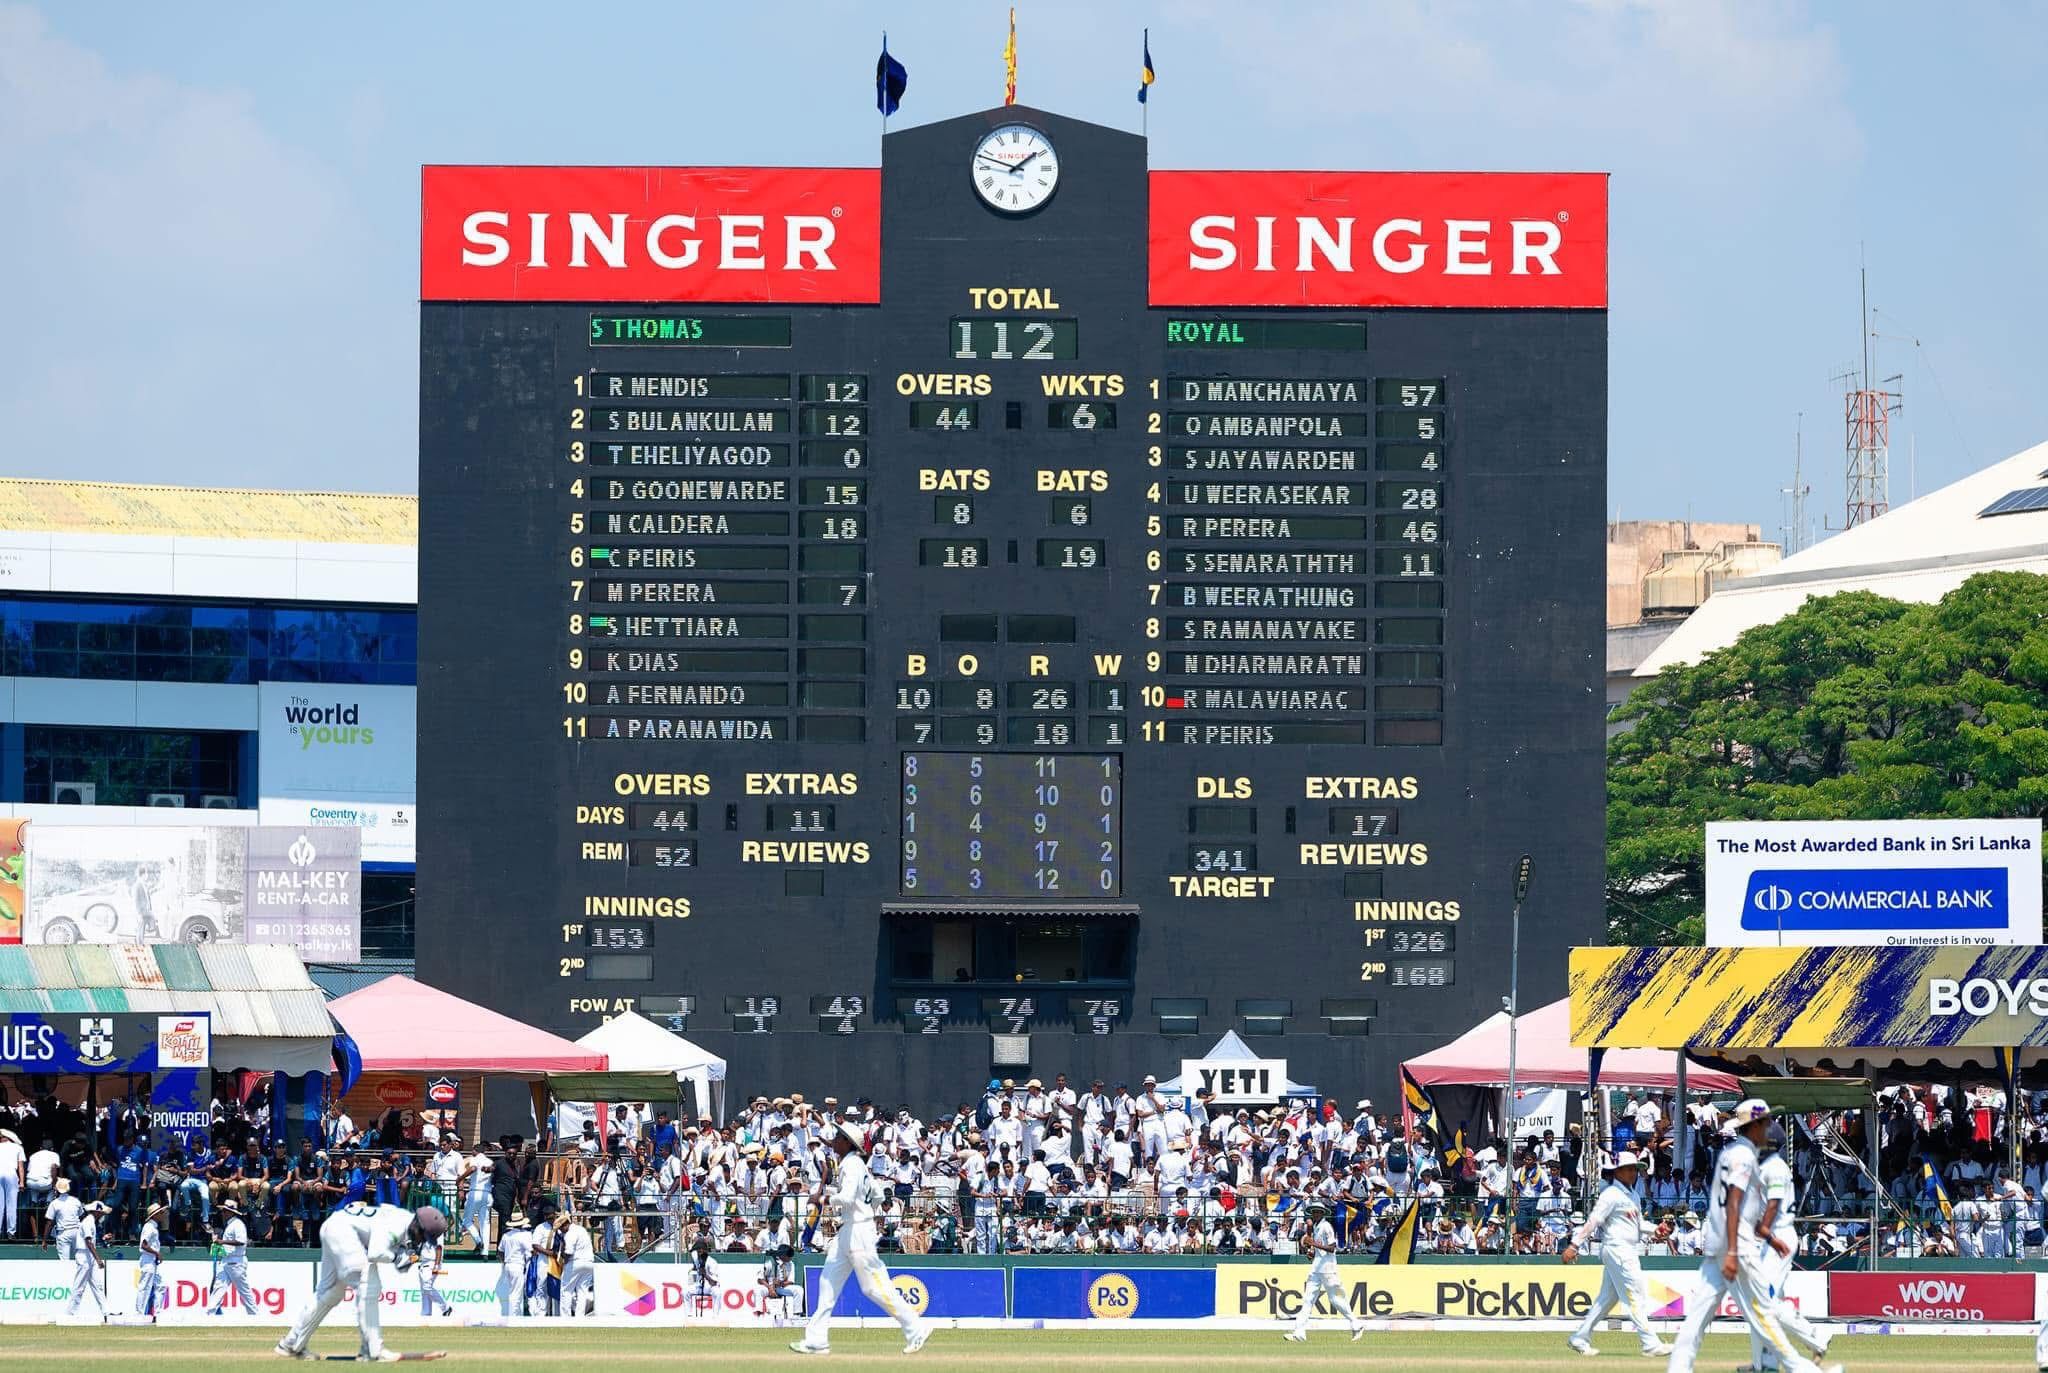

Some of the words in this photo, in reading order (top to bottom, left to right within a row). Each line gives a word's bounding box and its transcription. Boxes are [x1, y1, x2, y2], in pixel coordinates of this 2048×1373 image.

[969, 288, 1059, 309] TOTAL
[592, 320, 602, 338] S
[614, 320, 703, 338] THOMAS
[1168, 322, 1244, 342] ROYAL
[955, 322, 1054, 359] 112
[609, 378, 623, 396] R
[632, 378, 708, 396] MENDIS
[825, 383, 859, 402] 12
[897, 374, 992, 395] OVERS
[1041, 375, 1124, 396] WKTS
[1186, 383, 1199, 401] D
[1208, 383, 1357, 401] MANCHANAYA
[1401, 386, 1437, 407] 57
[609, 412, 620, 431] S
[628, 412, 773, 431] BULANKULAM
[825, 415, 860, 436] 12
[936, 408, 970, 430] 44
[1072, 404, 1096, 429] 6
[1186, 418, 1200, 436] O
[1208, 418, 1342, 436] AMBANPOLA
[1418, 418, 1435, 439] 5
[609, 446, 623, 465] T
[631, 446, 771, 465] EHELIYAGOD
[844, 449, 861, 468] 0
[1186, 451, 1197, 470] S
[1205, 451, 1354, 470] JAYAWARDEN
[1420, 452, 1437, 471] 4
[920, 469, 990, 490] BATS
[1038, 470, 1108, 491] BATS
[609, 481, 624, 500] D
[633, 481, 785, 500] GOONEWARDE
[824, 486, 858, 505] 15
[1185, 486, 1198, 504] U
[1207, 486, 1349, 504] WEERASEKAR
[1402, 489, 1437, 510] 28
[609, 515, 621, 533] N
[629, 515, 728, 533] CALDERA
[953, 504, 970, 524] 8
[1071, 505, 1087, 525] 6
[823, 519, 857, 539] 18
[1184, 518, 1196, 537] R
[1206, 518, 1291, 537] PERERA
[1402, 521, 1437, 542] 46
[609, 550, 620, 567] C
[628, 550, 696, 567] PEIRIS
[943, 547, 977, 567] 18
[1062, 547, 1096, 567] 19
[1185, 554, 1196, 572] S
[1205, 554, 1353, 572] SENARATHTH
[1400, 554, 1435, 576] 11
[608, 583, 622, 601] M
[631, 583, 716, 601] PERERA
[840, 586, 857, 606] 7
[1184, 587, 1196, 606] B
[1205, 587, 1354, 606] WEERATHUNG
[606, 617, 618, 636] S
[626, 617, 739, 636] HETTIARA
[1185, 621, 1195, 639] S
[1203, 621, 1355, 639] RAMANAYAKE
[608, 653, 621, 671] K
[629, 653, 679, 671] DIAS
[908, 655, 926, 675] B
[958, 655, 978, 675] O
[1031, 655, 1049, 675] R
[1094, 655, 1122, 675] W
[1185, 655, 1197, 673] N
[1205, 655, 1361, 673] DHARMARATN
[291, 696, 308, 705] The
[607, 686, 620, 704] A
[628, 686, 745, 704] FERNANDO
[897, 689, 931, 709] 10
[976, 689, 993, 709] 8
[1032, 689, 1067, 709] 26
[1184, 690, 1197, 709] R
[1206, 690, 1348, 709] MALAVIARAC
[286, 704, 358, 725] world
[290, 725, 297, 734] is
[300, 726, 374, 750] yours
[607, 720, 620, 739] A
[629, 720, 773, 739] PARANAWIDA
[914, 724, 931, 743] 7
[976, 724, 994, 744] 9
[1034, 724, 1068, 744] 18
[1184, 726, 1197, 744] R
[1206, 726, 1273, 744] PEIRIS
[1035, 757, 1056, 777] 11
[615, 774, 711, 796] OVERS
[746, 773, 858, 795] EXTRAS
[1197, 777, 1252, 799] DLS
[1306, 777, 1418, 799] EXTRAS
[1035, 785, 1059, 805] 10
[311, 808, 357, 820] Coventry
[577, 806, 624, 825] DAYS
[653, 810, 688, 832] 44
[790, 811, 825, 832] 11
[1352, 815, 1387, 836] 17
[582, 843, 622, 860] REM
[743, 841, 870, 863] REVIEWS
[1035, 841, 1059, 861] 17
[1301, 844, 1428, 865] REVIEWS
[1717, 839, 1749, 853] The
[1754, 838, 1796, 853] Most
[1801, 838, 1877, 852] Awarded
[1883, 837, 1925, 851] Bank
[1931, 837, 1946, 851] in
[1952, 836, 1974, 851] Sri
[1980, 836, 2031, 850] Lanka
[656, 847, 691, 867] 52
[1195, 850, 1247, 872] 341
[257, 871, 349, 888] MAL-KEY
[1035, 869, 1059, 889] 12
[1169, 877, 1274, 897] TARGET
[257, 892, 348, 904] RENT-A-CAR
[585, 897, 690, 917] INNINGS
[1798, 890, 1932, 910] COMMERCIAL
[1938, 890, 1992, 909] BANK
[1355, 901, 1460, 921] INNINGS
[272, 924, 351, 935] 0112365365
[562, 924, 583, 942] 1ST
[591, 928, 644, 949] 153
[1364, 928, 1385, 947] 1ST
[1392, 932, 1445, 952] 326
[1887, 936, 1905, 945] Our
[1909, 936, 1948, 945] interest
[1962, 936, 1971, 944] in
[560, 958, 584, 976] 2ND
[1361, 963, 1385, 981] 2ND
[1392, 967, 1444, 986] 168
[571, 999, 608, 1012] FOW
[614, 998, 634, 1012] AT
[745, 997, 778, 1016] 18
[828, 997, 863, 1015] 43
[914, 999, 949, 1015] 63
[999, 999, 1034, 1015] 74
[1084, 1000, 1120, 1016] 76
[1199, 1068, 1268, 1095] YETI
[153, 1111, 209, 1128] POWERED
[1530, 1116, 1553, 1126] UNIT
[1098, 1287, 1128, 1306] P&S
[1437, 1279, 1592, 1316] PickMe
[1899, 1280, 1966, 1304] WOW
